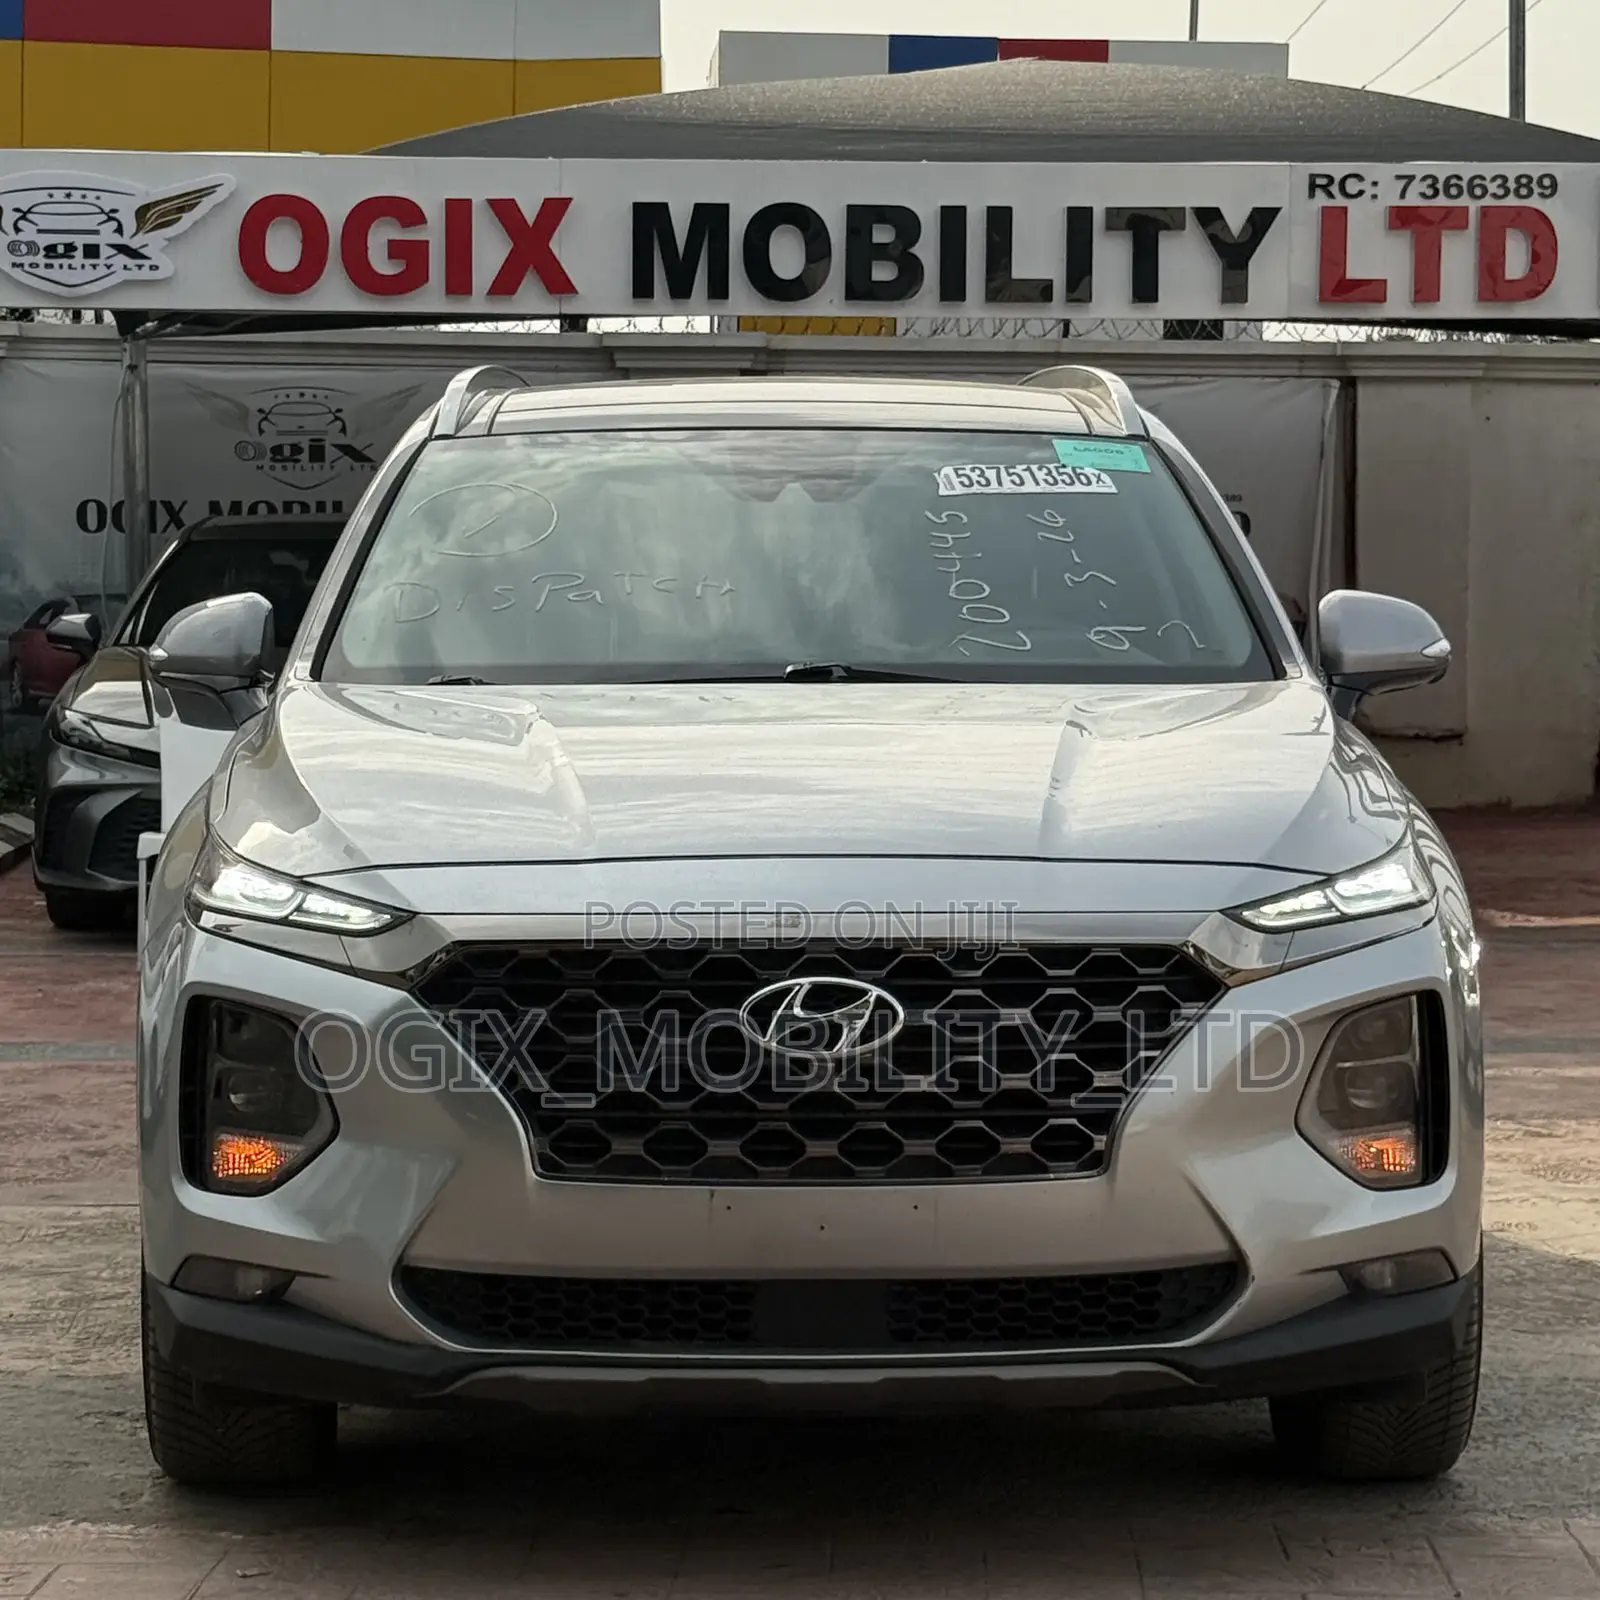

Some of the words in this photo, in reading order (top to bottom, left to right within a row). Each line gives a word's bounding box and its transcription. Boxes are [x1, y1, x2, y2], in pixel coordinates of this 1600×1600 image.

[1307, 173, 1379, 200] RC:
[1394, 173, 1558, 200] 7366389
[238, 193, 579, 298] OGIX
[631, 201, 1283, 304] MOBILITY
[1318, 205, 1559, 304] LTD
[11, 262, 114, 271] MOBILITY
[122, 264, 160, 272] LTD
[256, 464, 337, 472] MOBILITY
